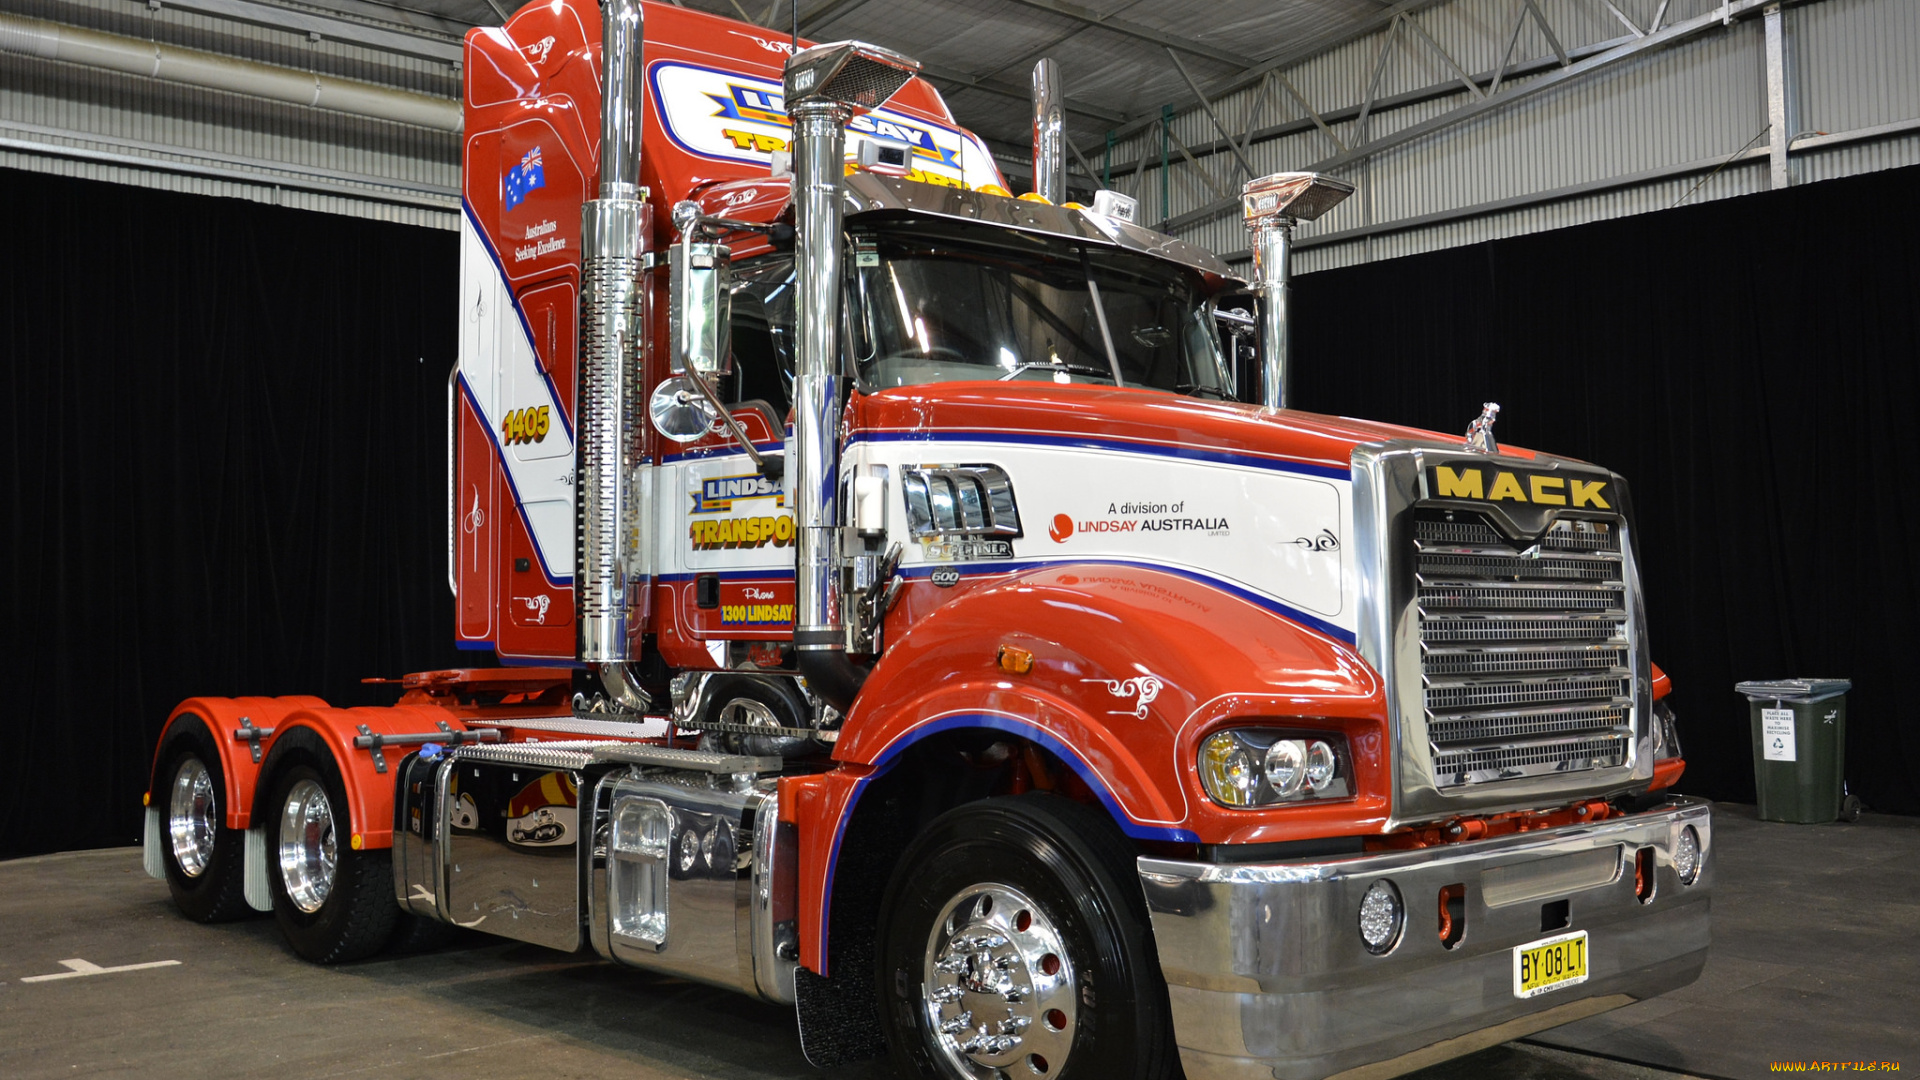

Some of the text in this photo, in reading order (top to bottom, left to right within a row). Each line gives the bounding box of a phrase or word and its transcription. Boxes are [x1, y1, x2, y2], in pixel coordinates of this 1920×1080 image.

[740, 89, 924, 147] LISAY
[524, 219, 557, 240] Australians
[515, 237, 566, 262] Seeking Excellence
[502, 405, 550, 446] 1405
[707, 478, 785, 499] LINDSA
[1435, 465, 1611, 509] MACK
[1108, 501, 1184, 514] A division of
[1078, 518, 1229, 533] LINDSAY AUSTRALIA
[931, 572, 960, 582] 600
[742, 587, 775, 600] Phone
[721, 604, 794, 625] 1300 LINDSAY
